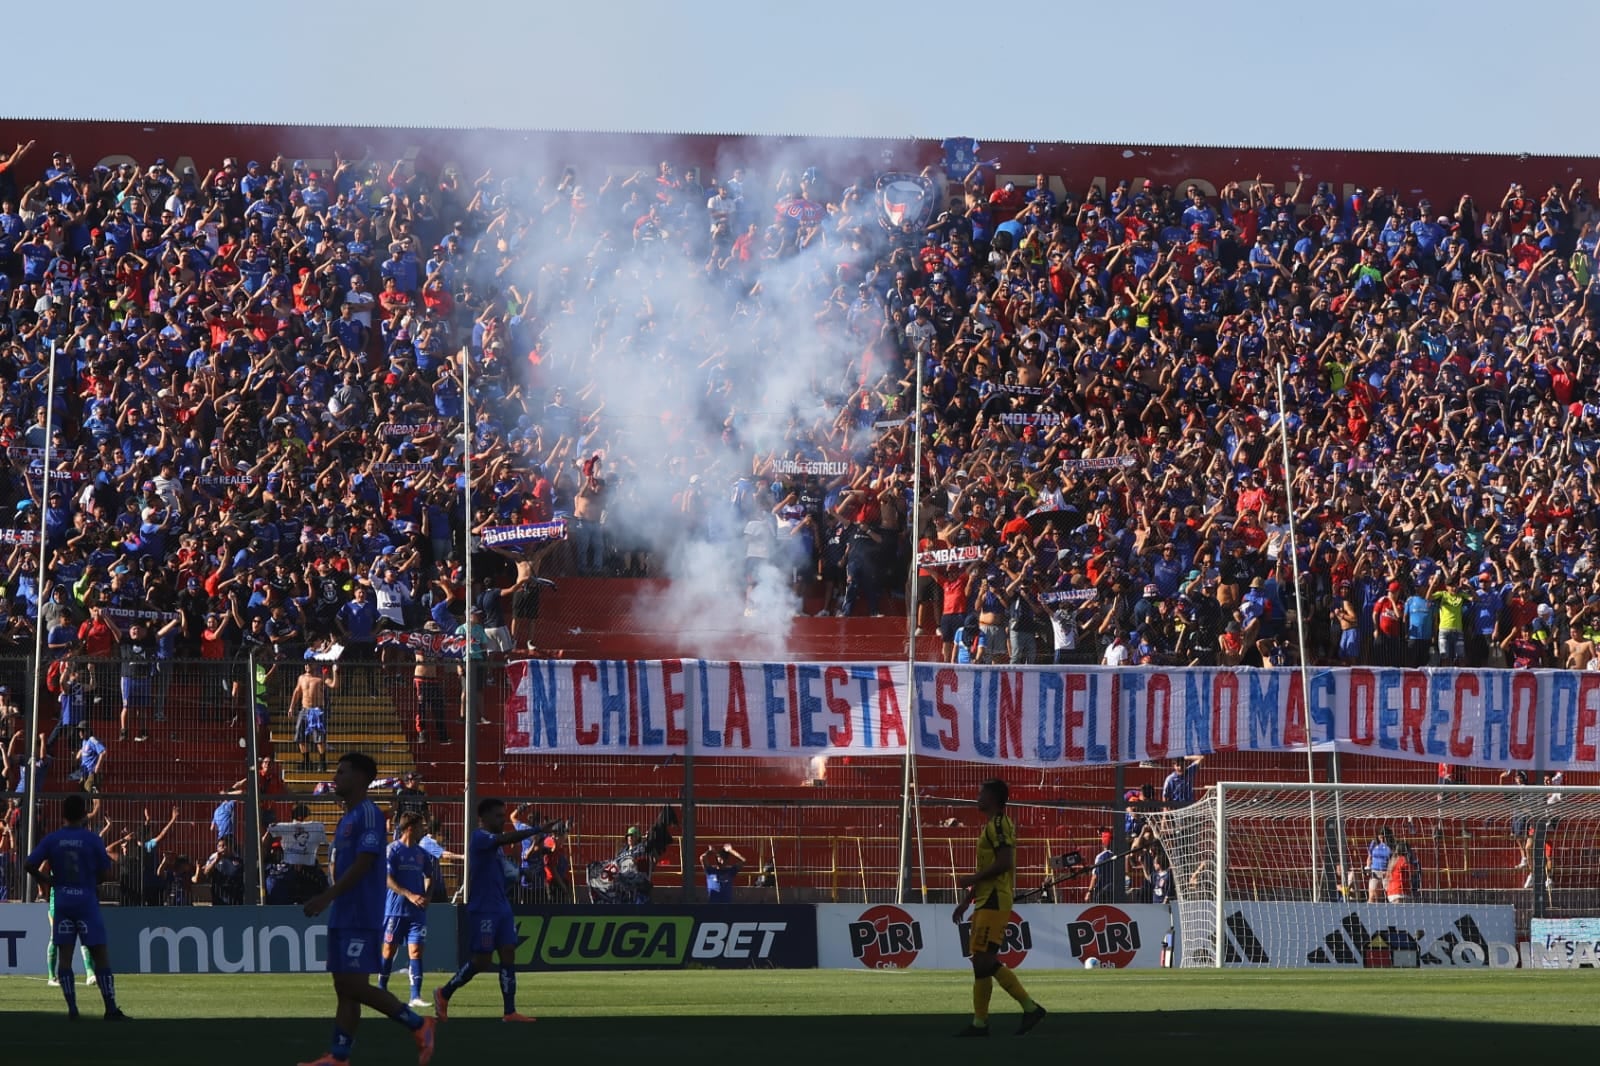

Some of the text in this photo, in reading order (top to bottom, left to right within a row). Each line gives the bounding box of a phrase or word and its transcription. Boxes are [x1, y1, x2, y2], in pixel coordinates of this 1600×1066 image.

[220, 475, 252, 485] REALES
[505, 658, 1600, 763] EN CHILE LA FIESTA ES UN DELITO NO MAS DERECHO DE
